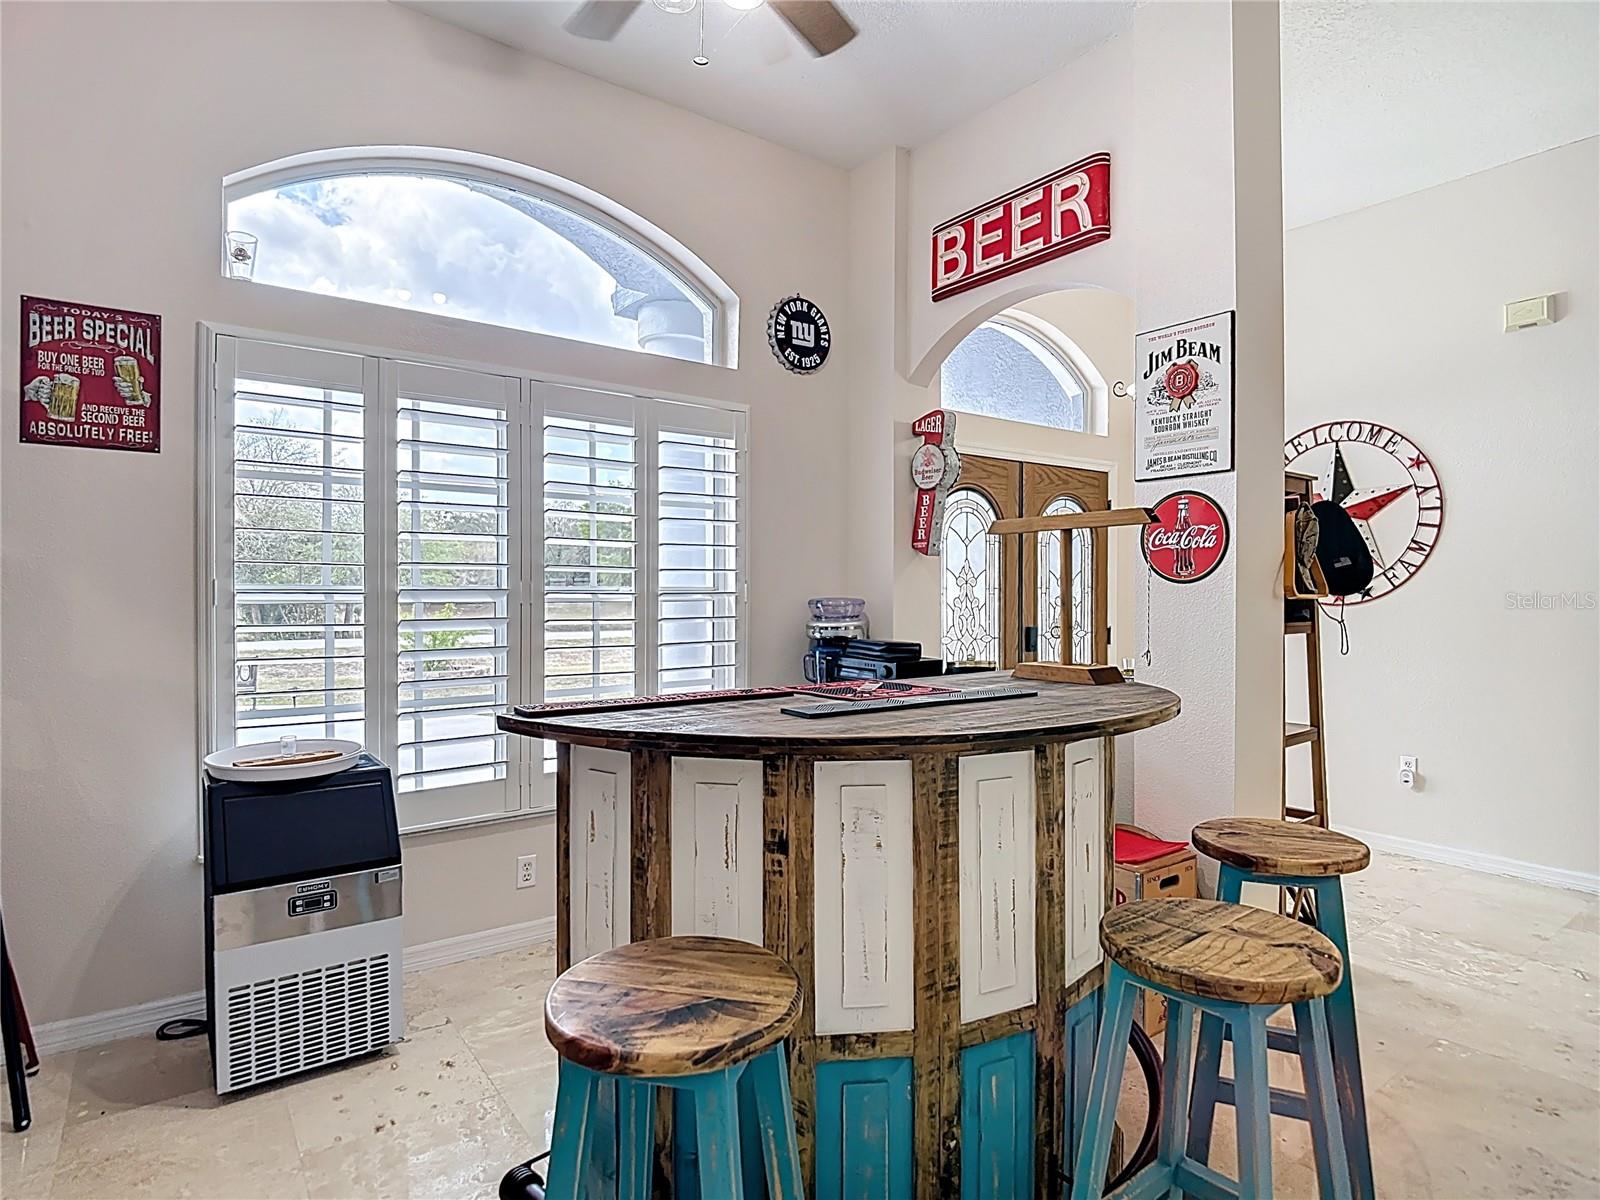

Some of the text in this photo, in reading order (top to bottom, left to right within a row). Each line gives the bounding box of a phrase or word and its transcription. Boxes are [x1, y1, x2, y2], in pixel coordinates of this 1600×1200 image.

[937, 172, 1092, 288] BEER
[62, 306, 123, 320] TODAY'S
[776, 300, 829, 348] NEW YORK GIANTS
[29, 312, 155, 366] BEER SPECIAL
[38, 350, 105, 369] BUY ONE BEER
[784, 347, 821, 368] EST. 1925
[1143, 338, 1222, 380] JIM BEAM
[38, 362, 105, 376] FOR THE PRICE OF TWO
[81, 403, 145, 416] AND RECEIVE THE
[81, 411, 145, 427] SECOND BEER
[1150, 414, 1181, 426] KENTUCKY
[1182, 409, 1212, 421] STRAIGHT
[29, 420, 153, 443] ABSOLUTELY FREE!
[915, 414, 942, 433] LAGER
[1153, 422, 1181, 434] BOURBON
[1182, 418, 1210, 429] WHISKEY
[1145, 457, 1163, 471] JAMES
[1168, 454, 1182, 462] BEAM
[1182, 451, 1209, 461] DISTILLING
[1284, 421, 1443, 590] ELCOME FAMILY
[917, 494, 930, 540] BEER
[1149, 524, 1219, 551] Coca-Cola
[298, 882, 329, 893] EUHOMY
